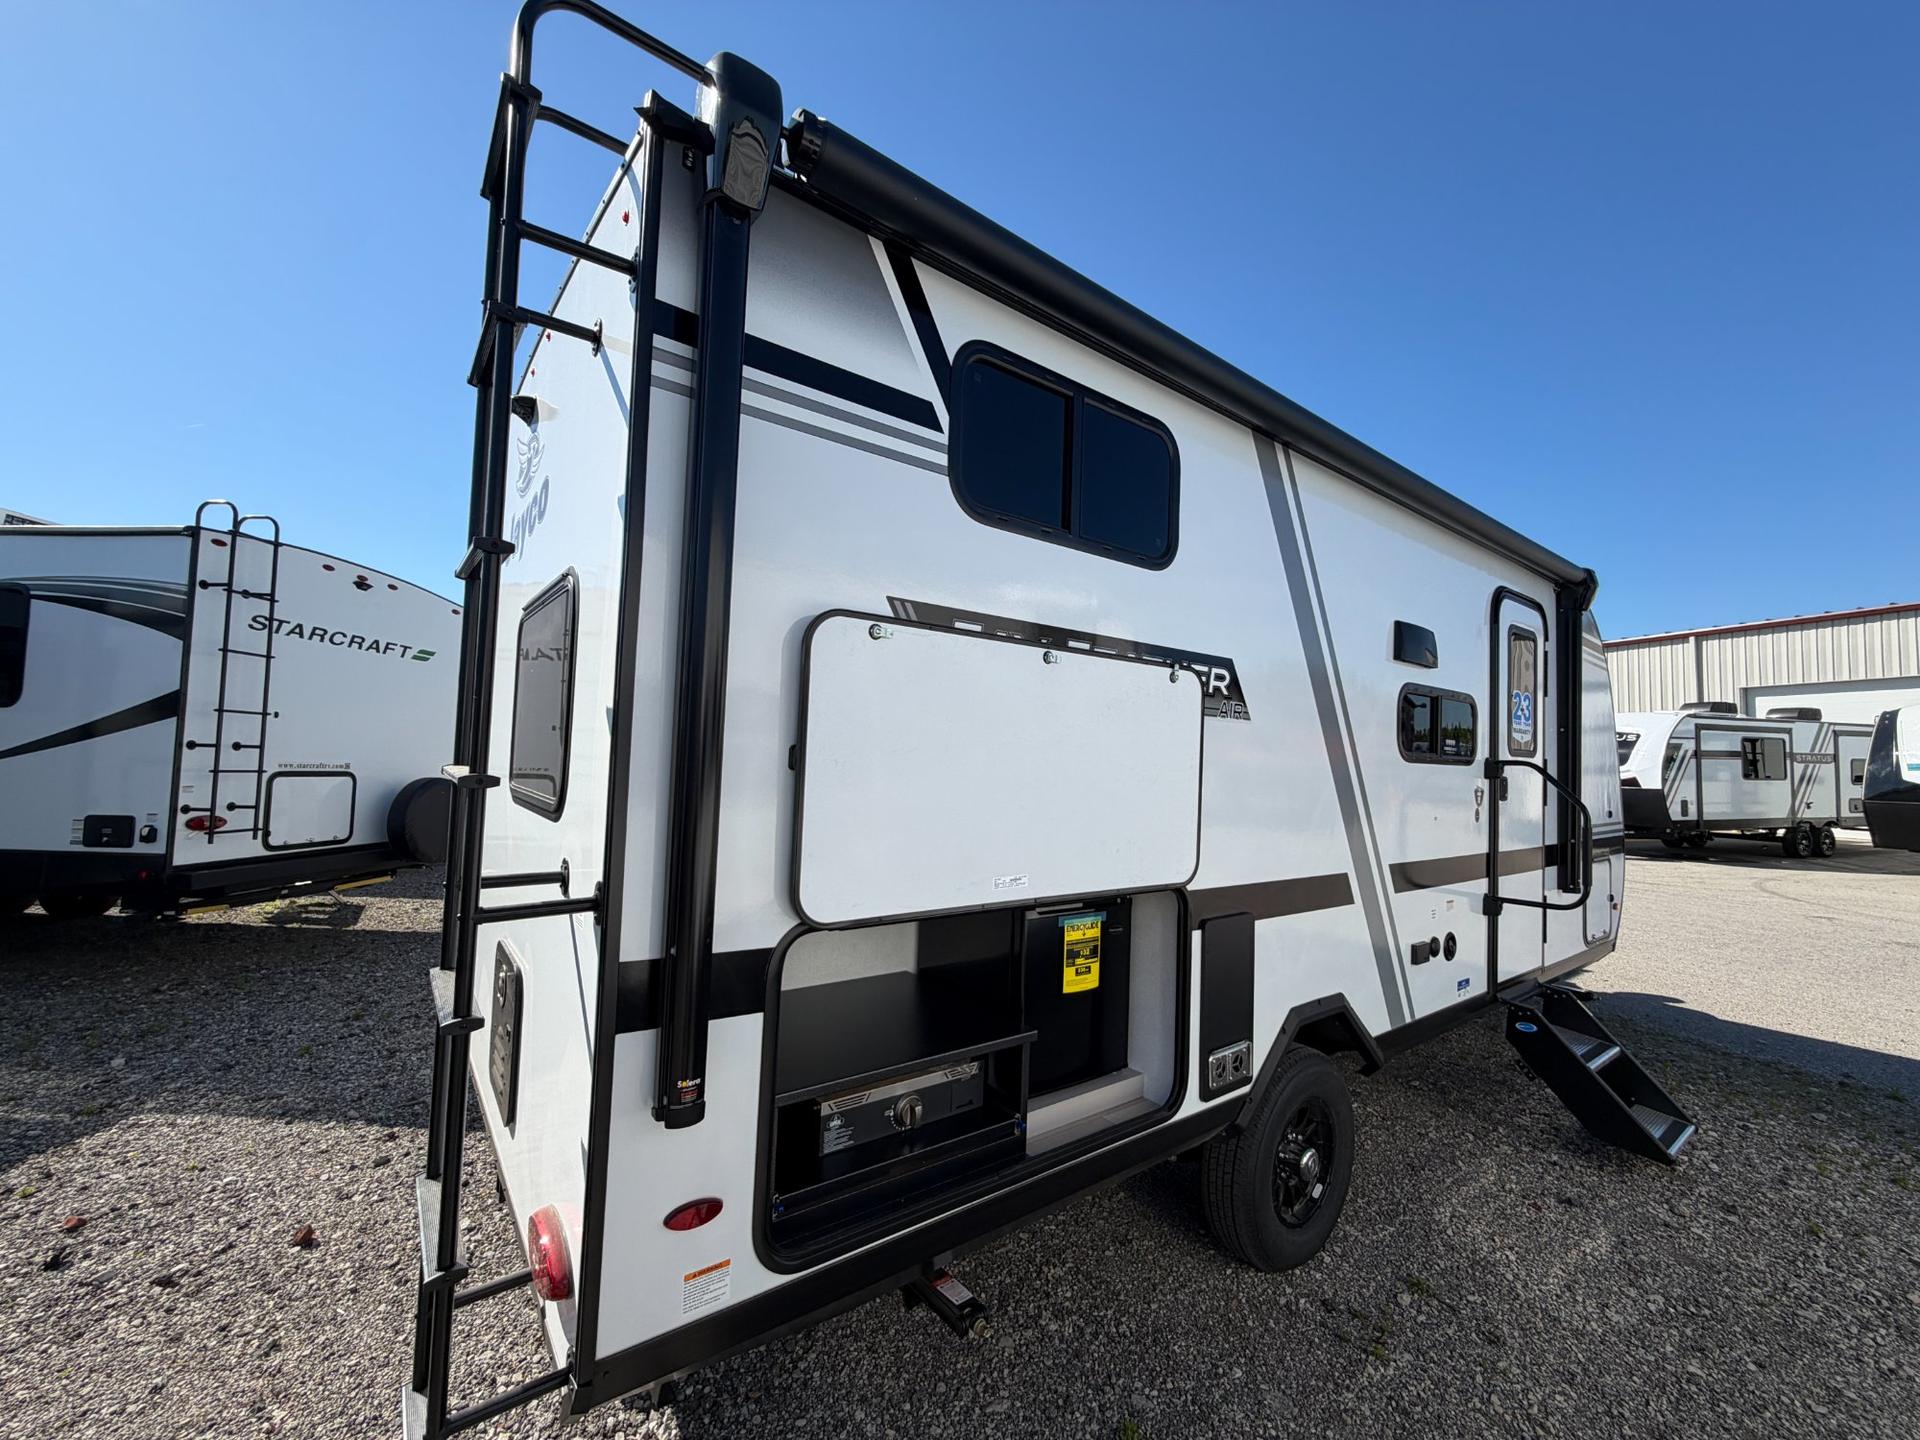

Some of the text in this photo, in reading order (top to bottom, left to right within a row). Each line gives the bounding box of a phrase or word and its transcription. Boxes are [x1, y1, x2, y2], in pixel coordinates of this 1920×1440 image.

[247, 614, 412, 658] STARCRAFT
[1217, 699, 1244, 720] AIR
[1795, 754, 1832, 763] STRATUS
[677, 1078, 701, 1088] Solera
